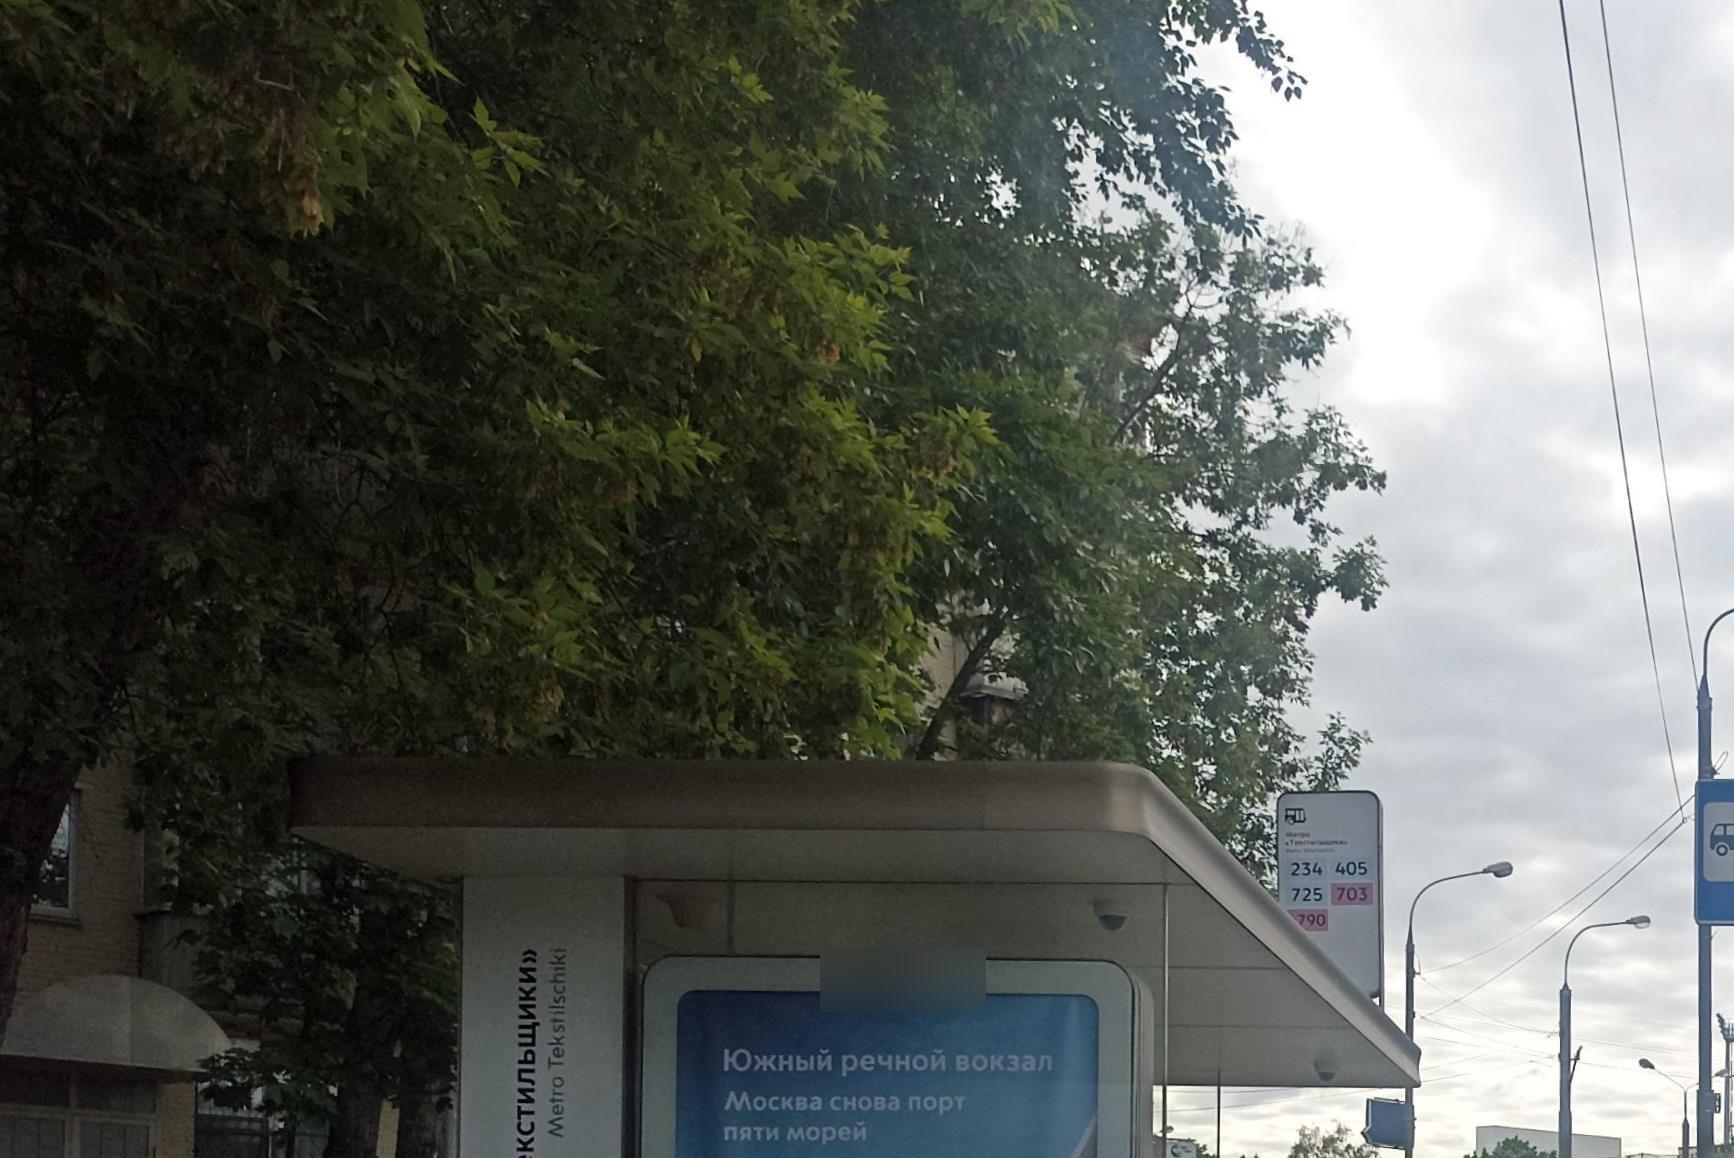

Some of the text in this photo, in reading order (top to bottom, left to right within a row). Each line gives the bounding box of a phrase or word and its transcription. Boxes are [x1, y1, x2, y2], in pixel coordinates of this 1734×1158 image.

[1291, 861, 1367, 876] 234 405
[1292, 887, 1368, 902] 725 703
[1297, 913, 1326, 927] 790
[547, 947, 567, 1138] Metro Tekstilschiki
[723, 1048, 1053, 1077] Южный речной вокзал
[724, 1090, 966, 1116] Москва снова порт
[723, 1121, 867, 1145] пяти морей
